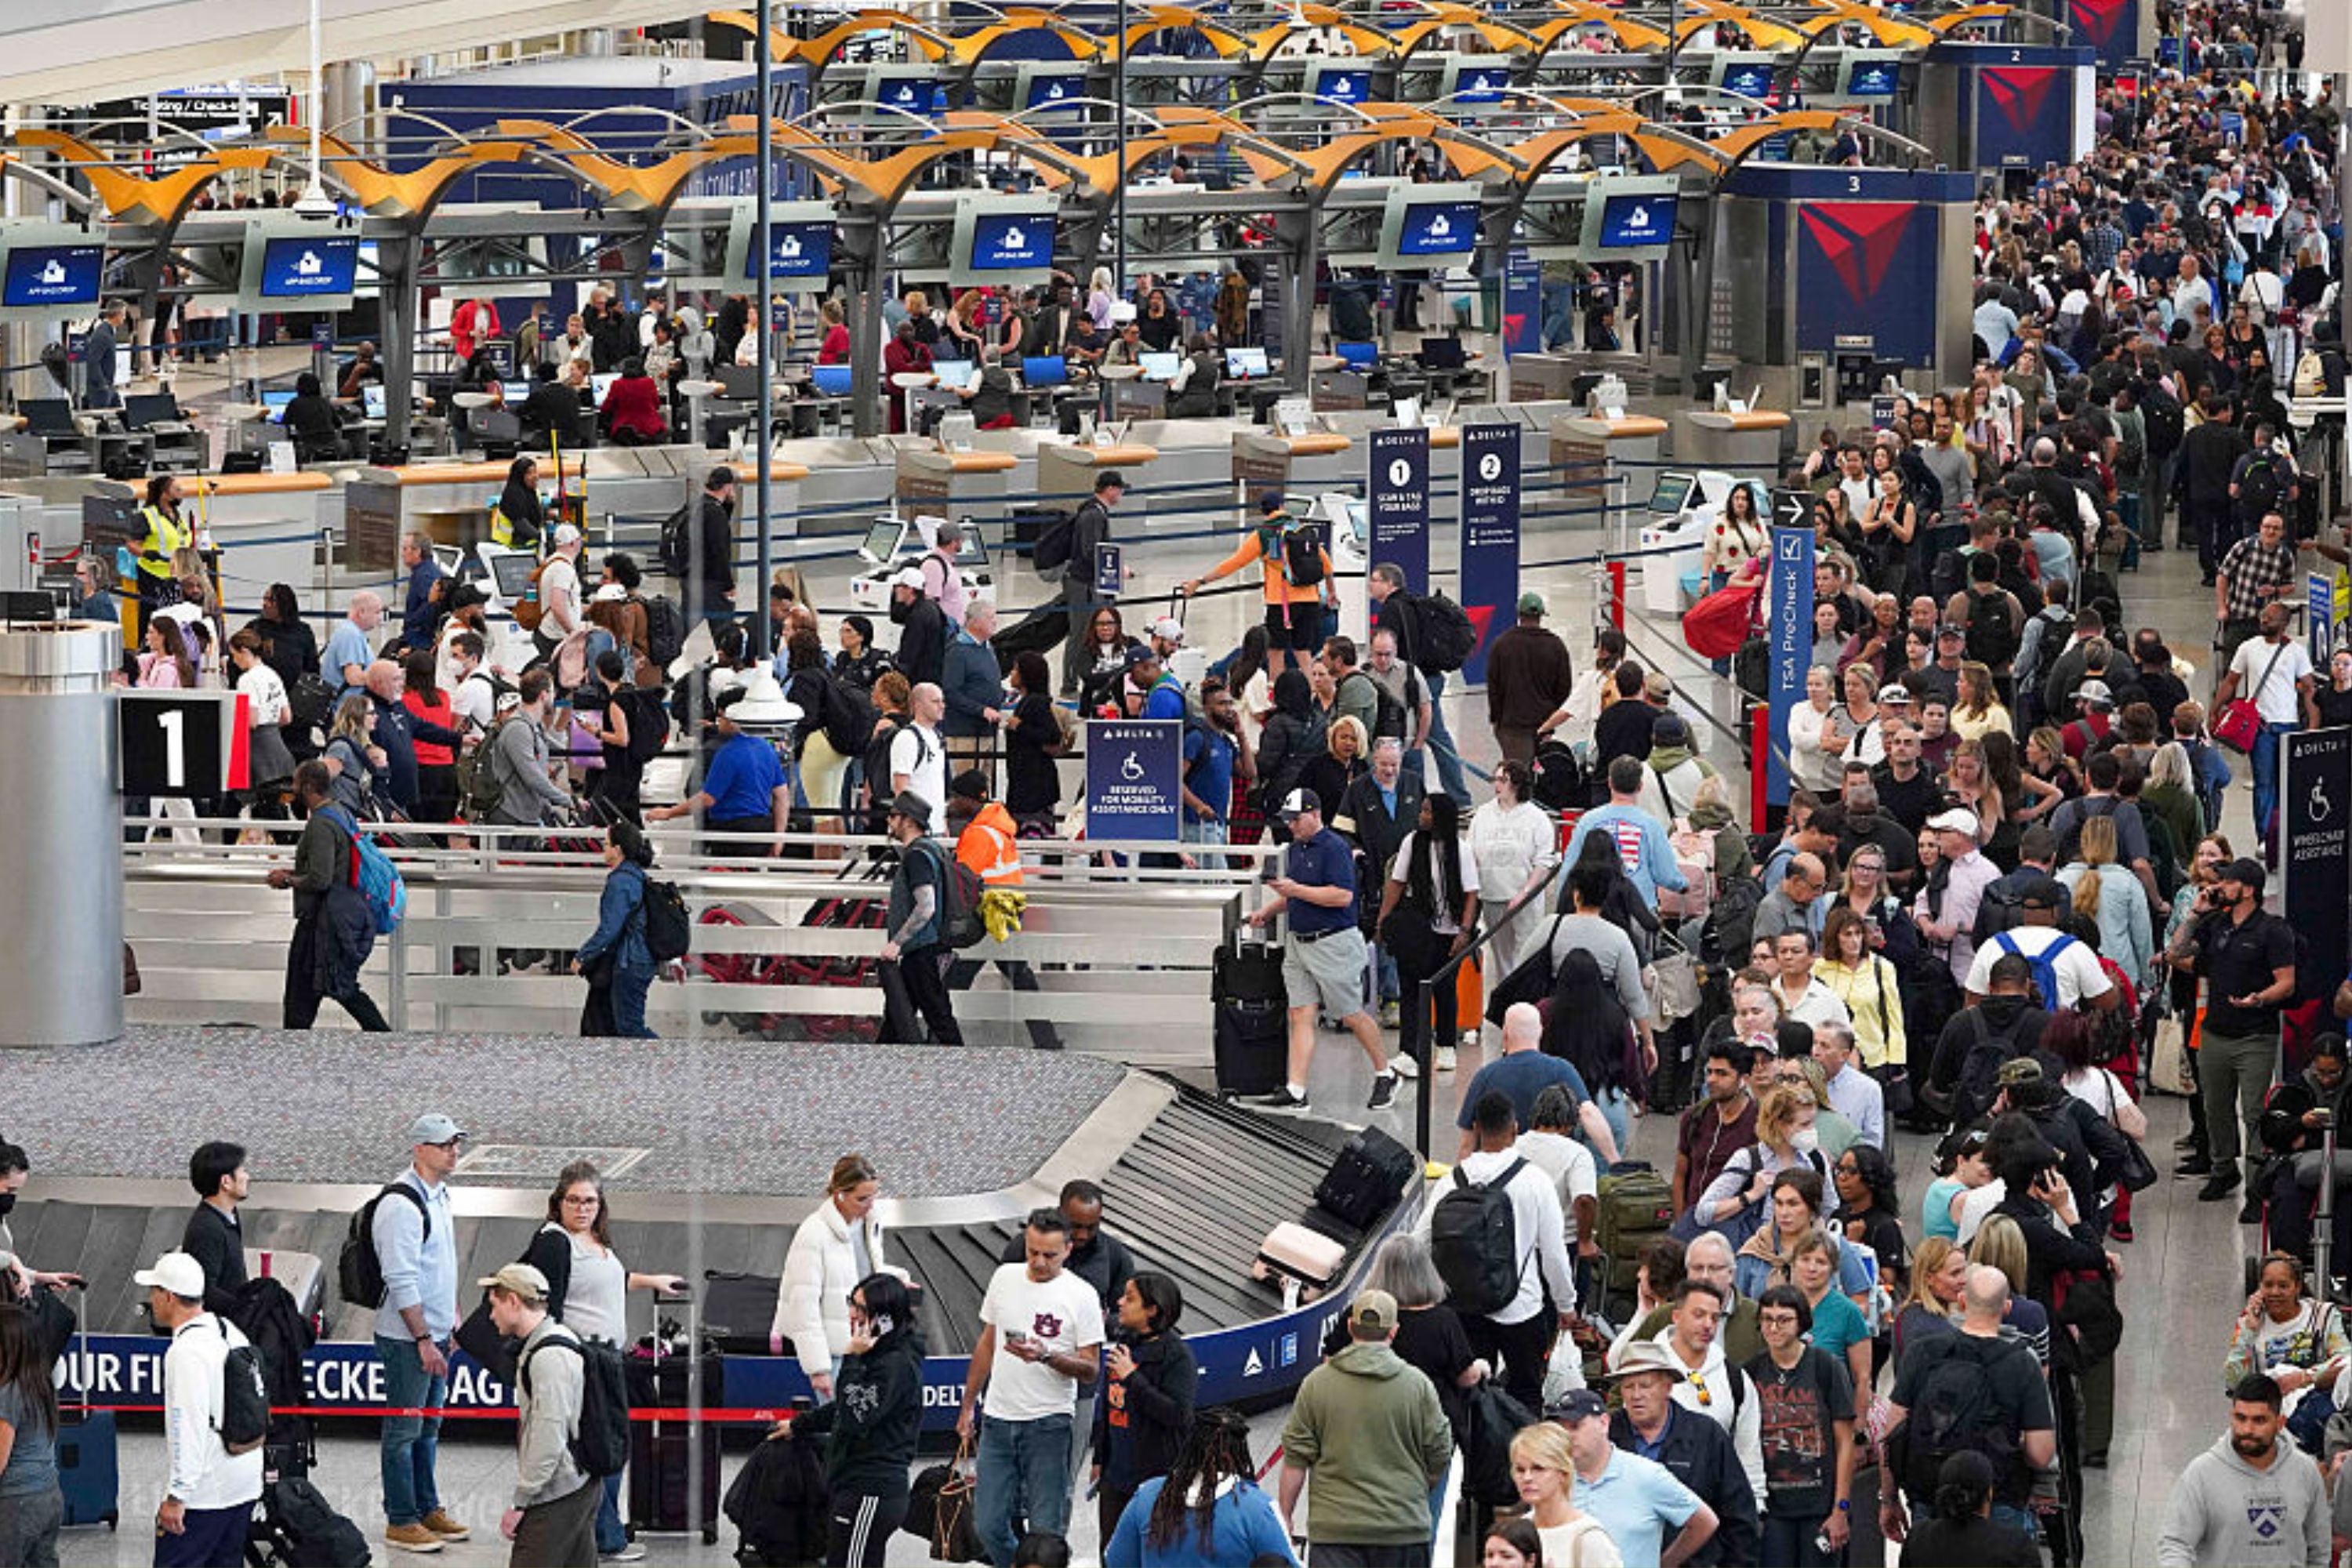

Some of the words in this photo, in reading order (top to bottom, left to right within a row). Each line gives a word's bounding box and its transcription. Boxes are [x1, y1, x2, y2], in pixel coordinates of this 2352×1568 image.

[2011, 50, 2020, 61] 2
[1849, 176, 1860, 192] 3
[1386, 436, 1414, 445] DELTA
[1478, 431, 1506, 441] DELTA
[1396, 465, 1403, 481] 1
[1485, 459, 1496, 474] 2
[1379, 503, 1399, 512] YOUR
[1782, 658, 1794, 691] TSA
[1116, 729, 1152, 738] DELTA
[158, 710, 184, 786] 1
[2304, 741, 2337, 755] DELTA
[1109, 786, 1156, 794] RESERVED
[1102, 795, 1120, 804] FOR
[1121, 795, 1166, 804] MOBILITY
[1091, 805, 1147, 814] ASSISTANCE
[1149, 805, 1175, 814] ONLY
[2293, 829, 2345, 848] WHEELCHAIR
[2294, 844, 2342, 861] ASSISTANCE
[302, 1359, 387, 1402] ECKE
[445, 1366, 503, 1406] AG
[922, 1385, 983, 1407] DELT
